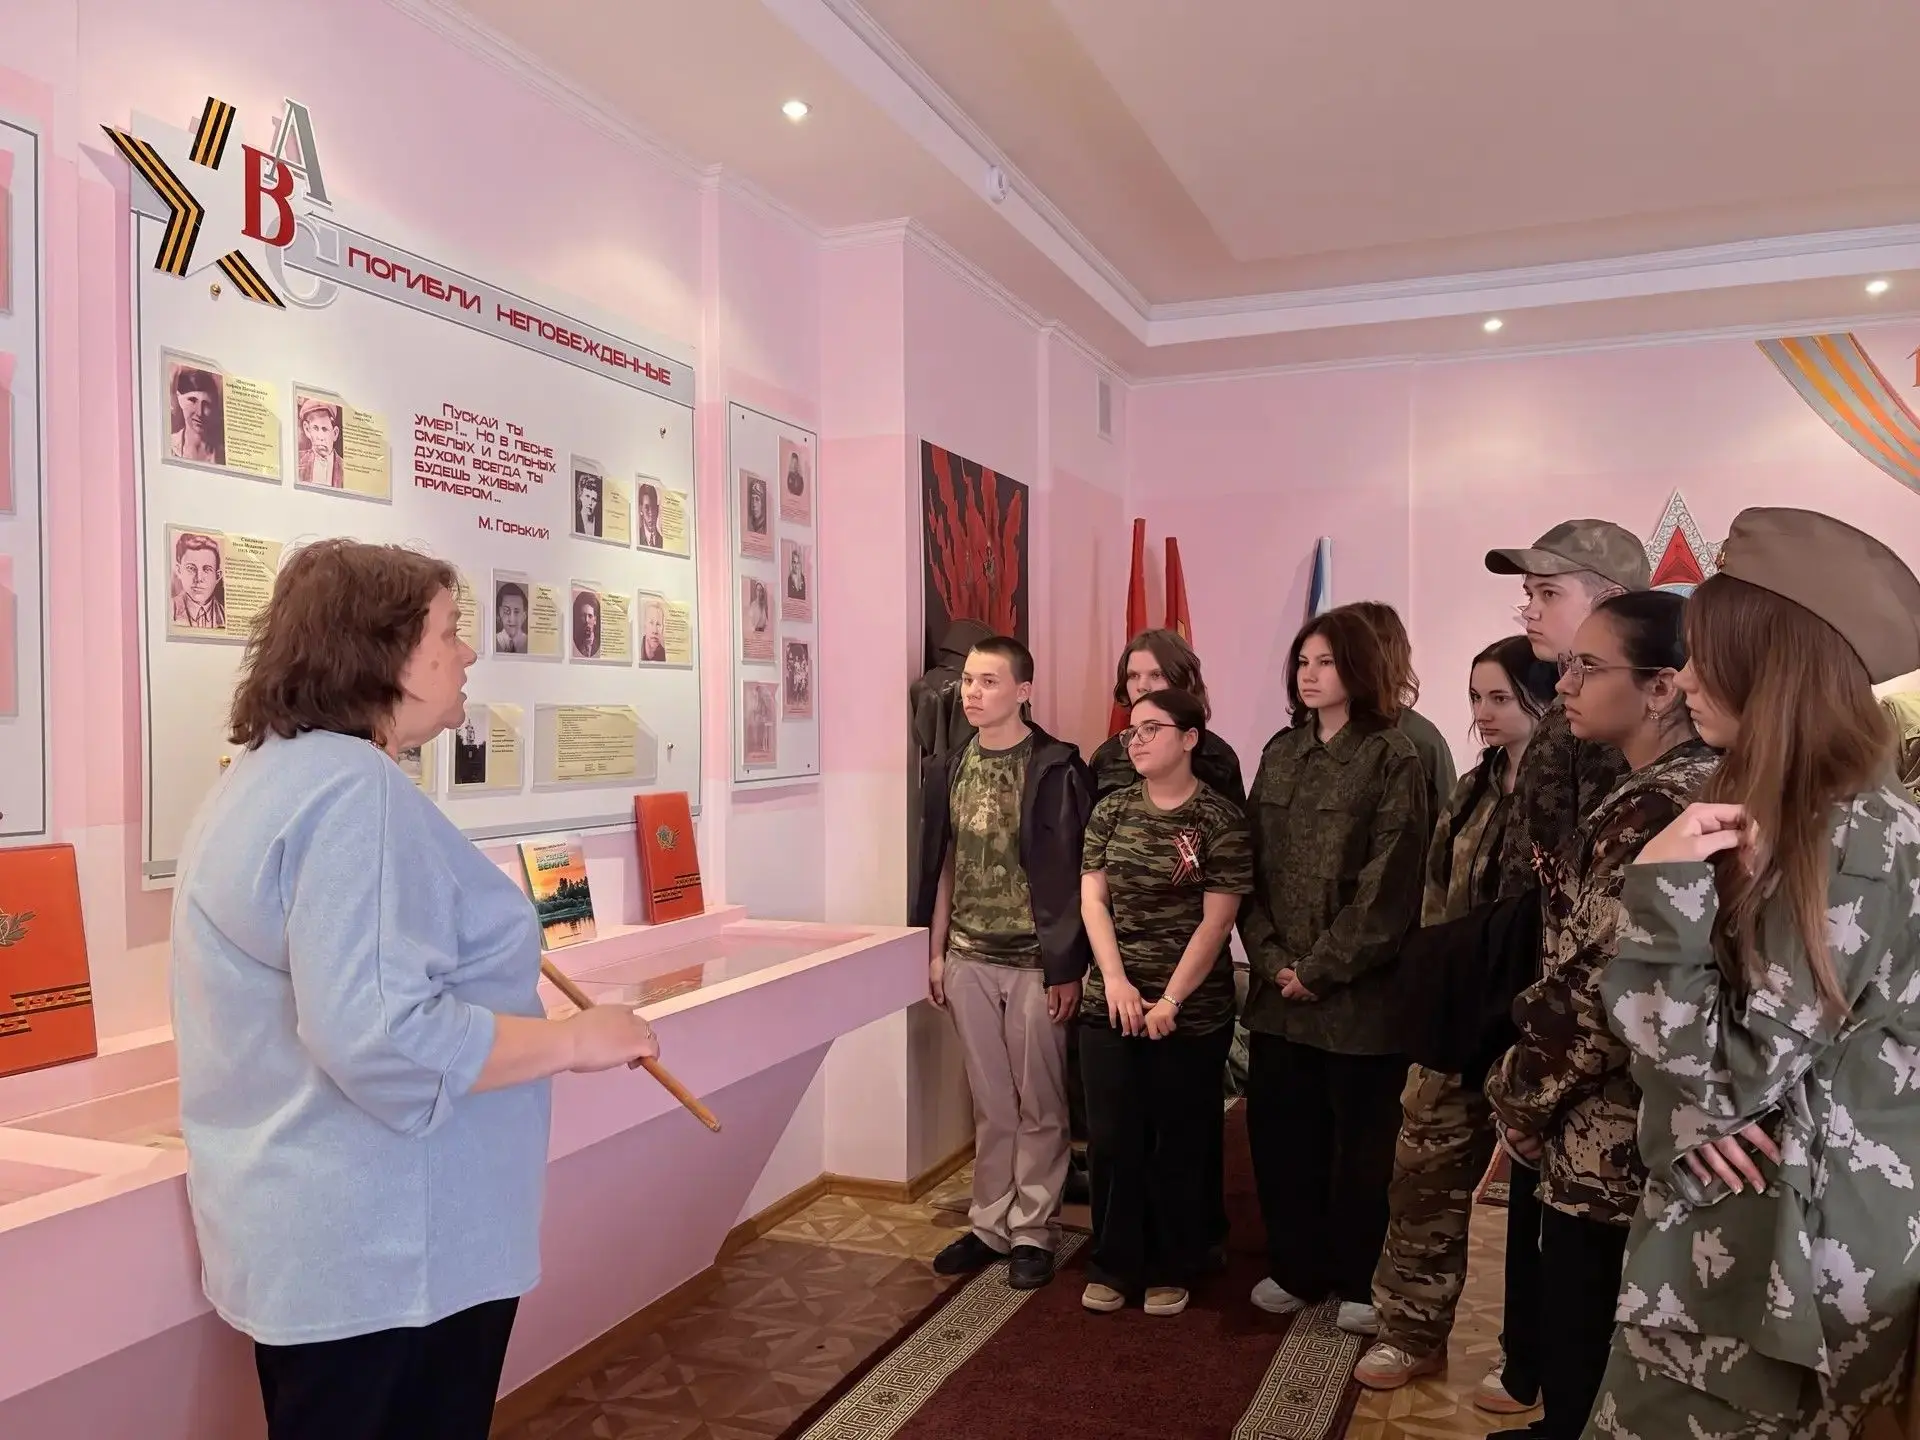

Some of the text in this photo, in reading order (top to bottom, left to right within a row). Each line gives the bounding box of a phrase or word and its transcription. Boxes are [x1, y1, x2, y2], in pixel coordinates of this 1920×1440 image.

[348, 246, 671, 386] ПОГИБЛИ НЕПОБЕЖДЕННЫЕ
[476, 427, 495, 443] НО
[499, 435, 509, 447] В
[514, 439, 553, 459] ПЕСНЕ
[506, 422, 524, 437] ТЫ
[414, 429, 556, 473] СМЕЛЫХ И СИЛЬНЫХ
[414, 445, 544, 484] ДУХОМ ВСЕГДА ТЫ
[414, 460, 528, 494] БУДЕШЬ ЖИВЫМ
